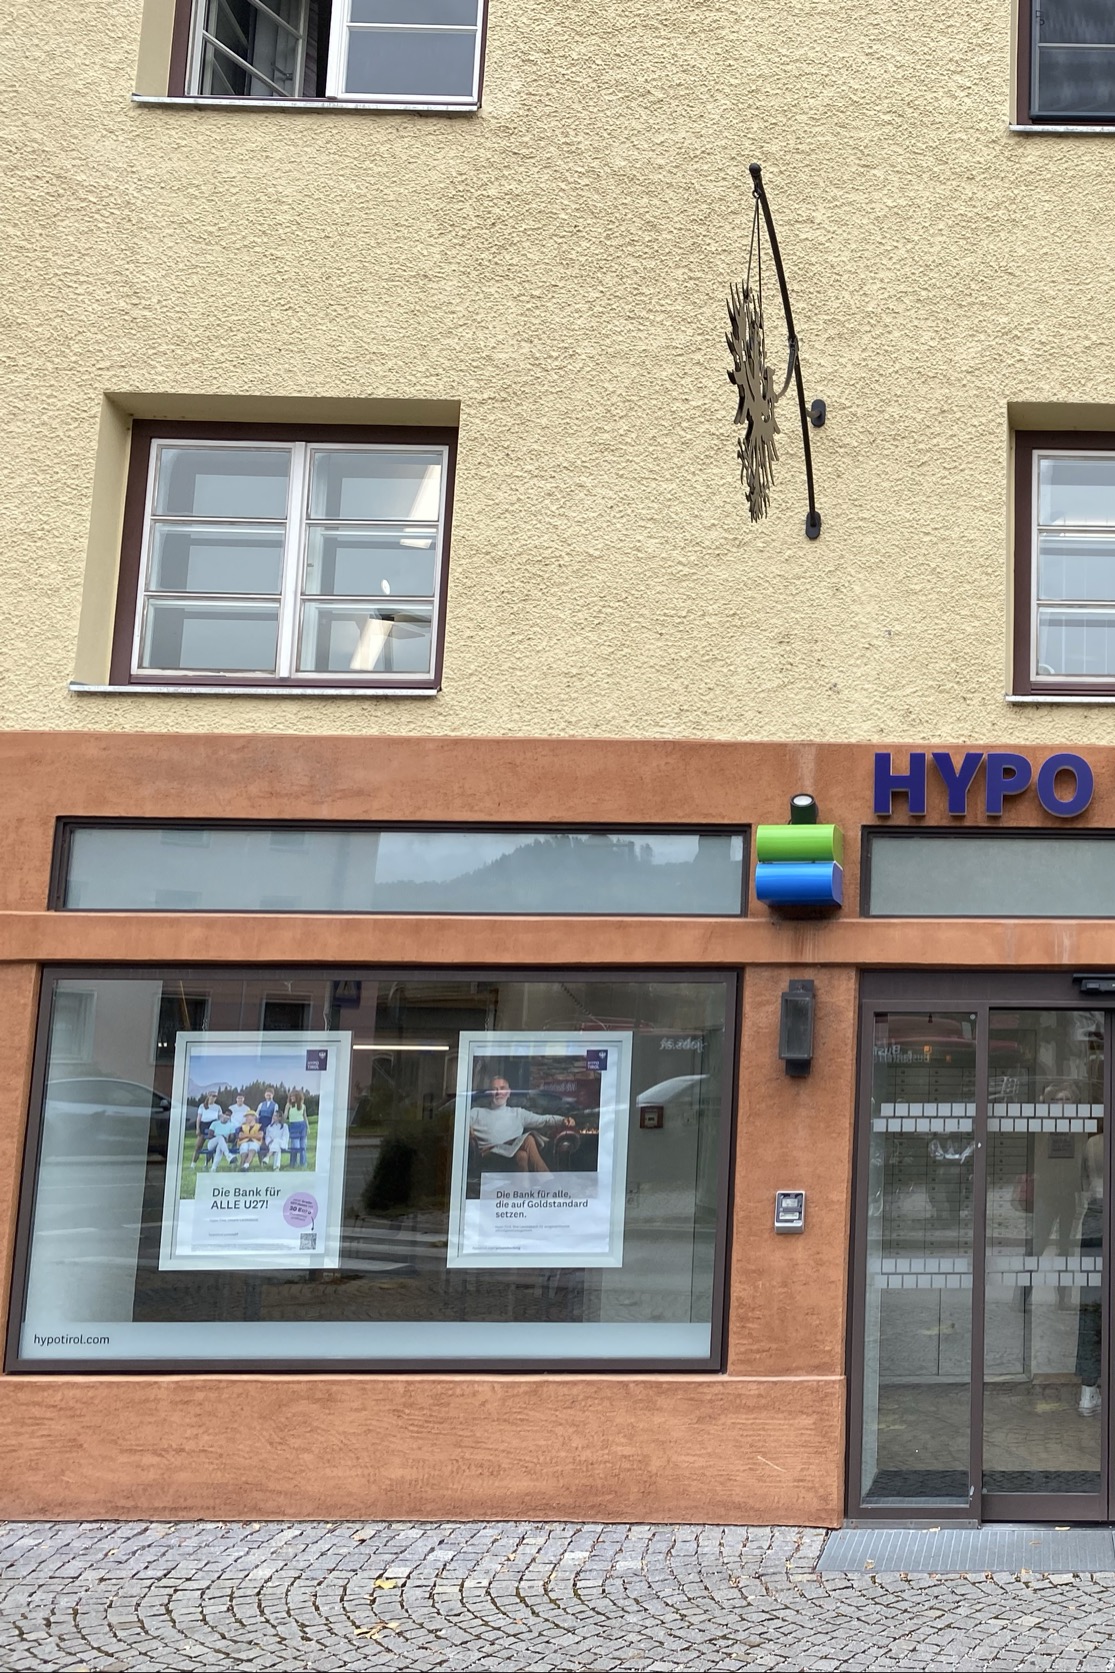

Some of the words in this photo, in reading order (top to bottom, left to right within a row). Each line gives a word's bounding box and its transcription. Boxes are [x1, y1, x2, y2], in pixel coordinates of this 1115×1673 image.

[874, 752, 1095, 817] HYPO
[212, 1188, 231, 1197] Die
[233, 1187, 261, 1197] Bank
[265, 1187, 281, 1197] für
[496, 1190, 511, 1199] Die
[512, 1190, 535, 1199] Bank
[537, 1190, 550, 1198] für
[552, 1190, 572, 1199] alle,
[210, 1200, 240, 1210] ALLE
[244, 1200, 269, 1209] U27!
[495, 1200, 510, 1208] die
[511, 1200, 525, 1208] auf
[527, 1199, 589, 1208] Goldstandard
[495, 1210, 527, 1218] setzen.
[33, 1333, 110, 1347] hypotirol.com
